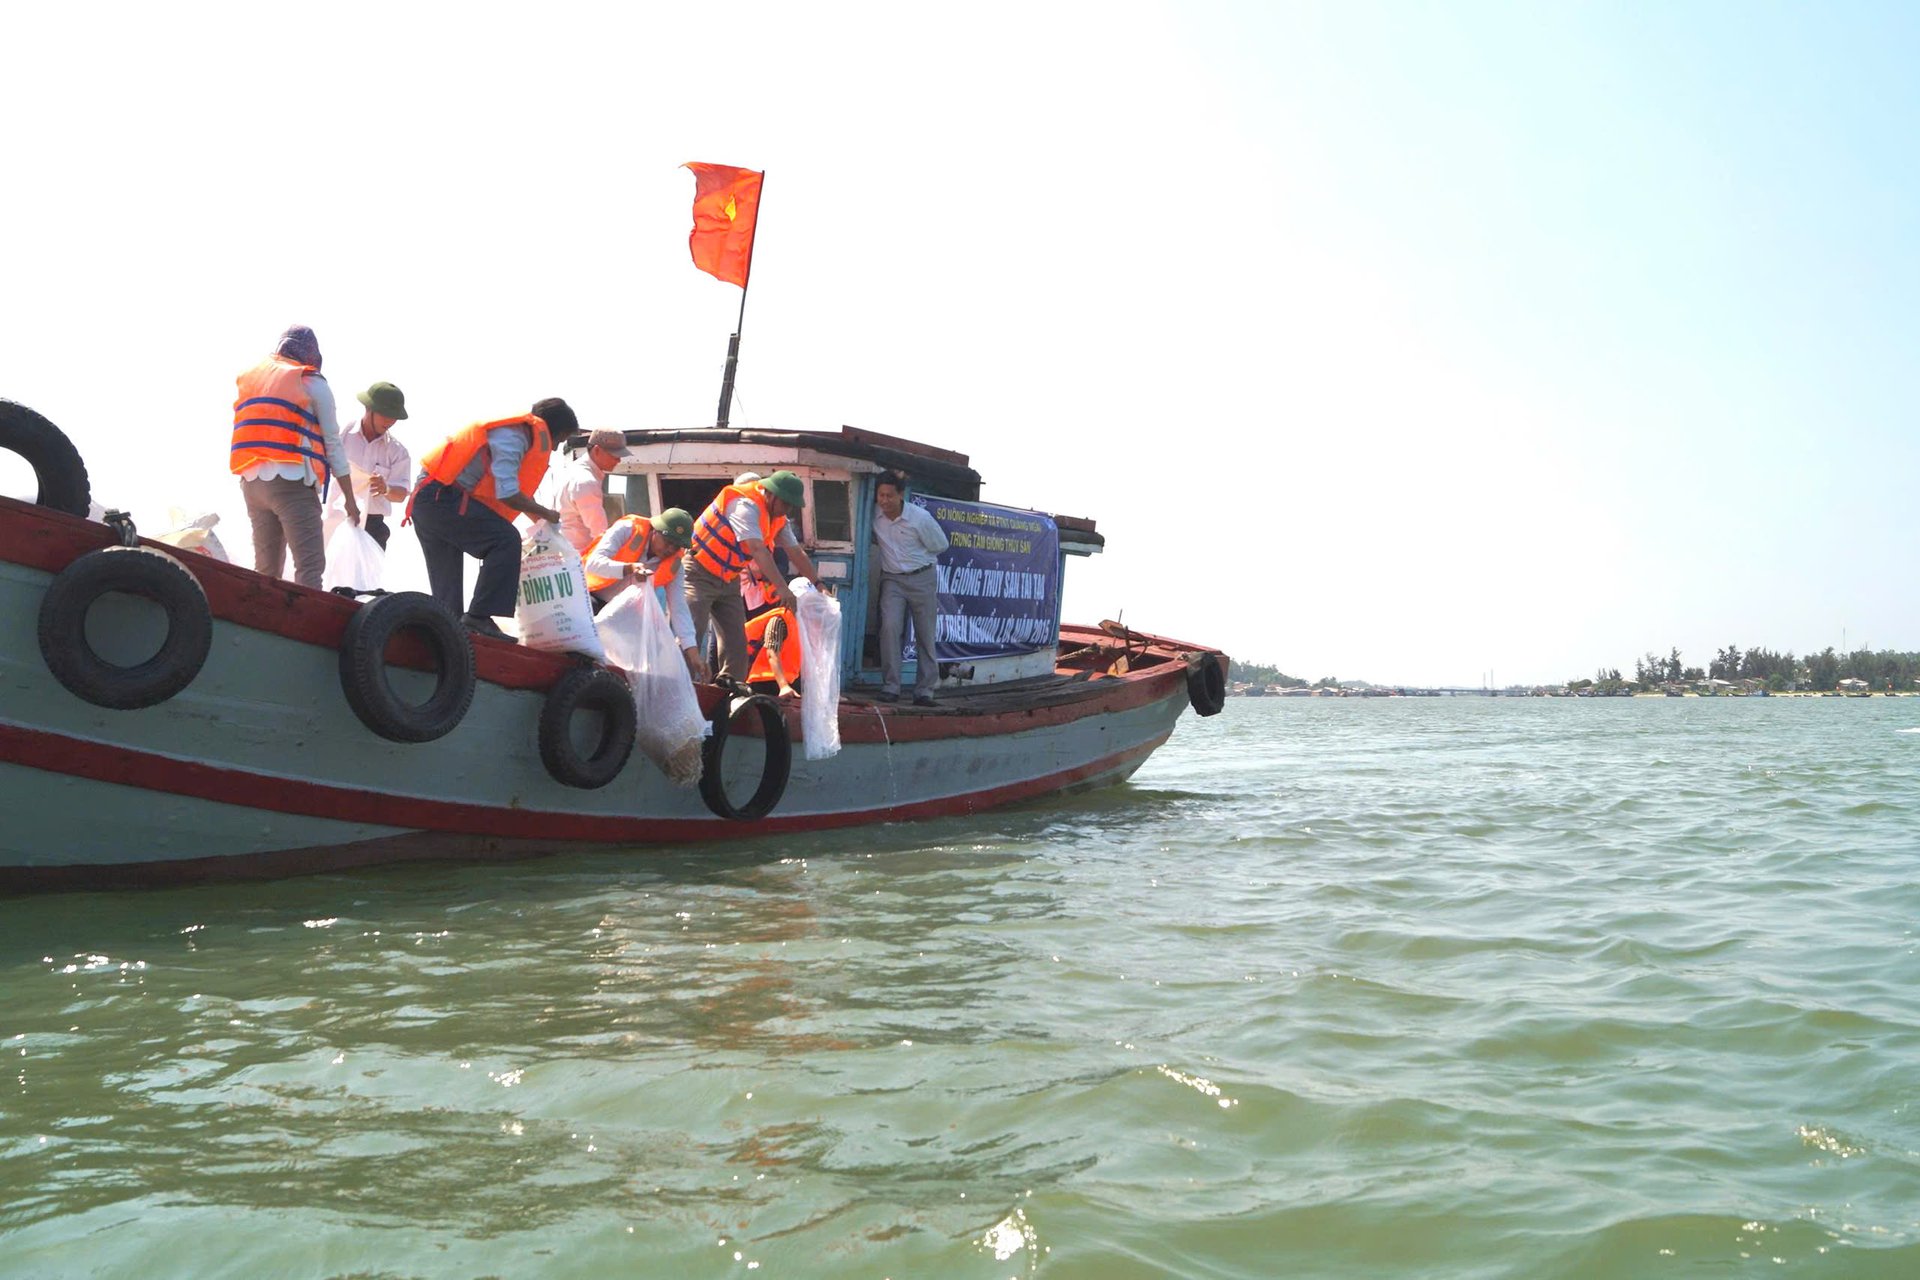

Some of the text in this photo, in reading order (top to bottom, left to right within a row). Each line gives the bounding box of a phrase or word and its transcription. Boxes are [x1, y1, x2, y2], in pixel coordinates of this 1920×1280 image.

[937, 504, 946, 519] SỞ
[947, 508, 965, 523] NÔNG
[950, 531, 972, 548] TRUNG
[973, 531, 986, 549] TÂM
[950, 558, 982, 597] GIỐNG
[1004, 563, 1020, 599] SẢN
[1021, 567, 1032, 600] TÁI
[1033, 573, 1046, 606] TẠO
[944, 604, 967, 643] TRIỂN
[1010, 613, 1034, 644] NĂM
[1029, 618, 1051, 645] 2015
